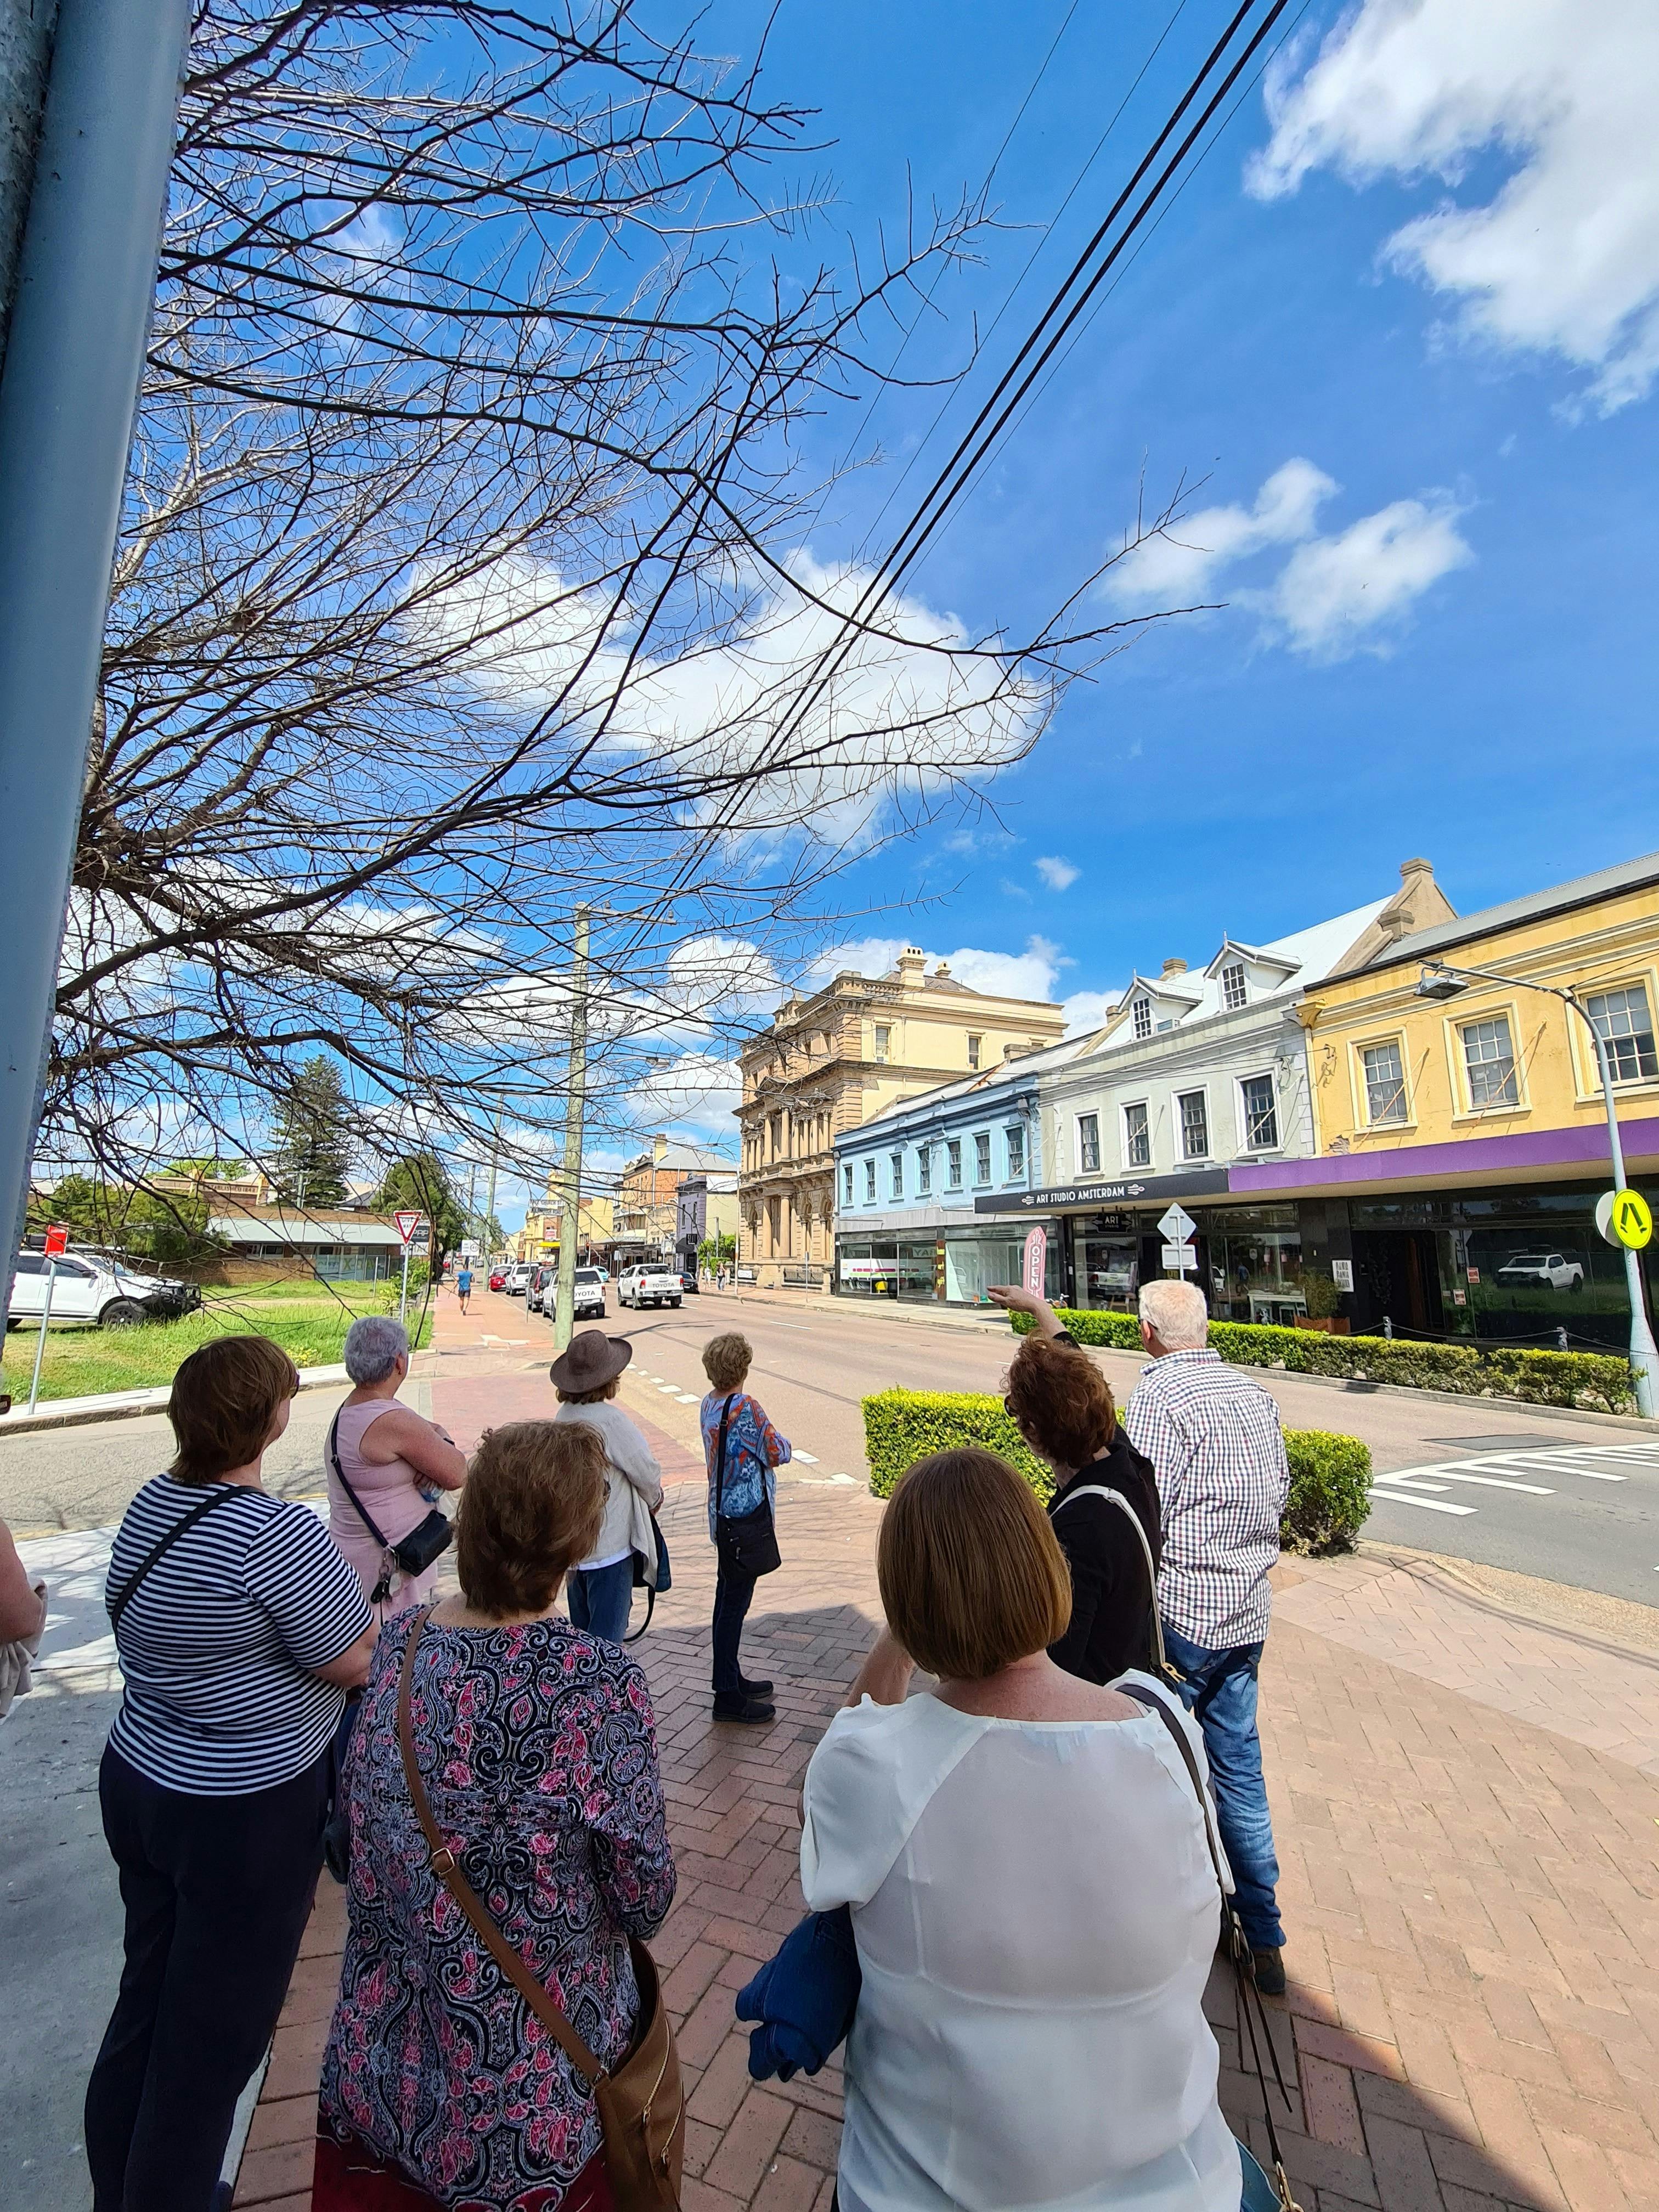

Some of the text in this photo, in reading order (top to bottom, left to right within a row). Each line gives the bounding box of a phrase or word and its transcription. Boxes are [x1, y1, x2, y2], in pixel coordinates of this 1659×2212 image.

[1036, 1186, 1125, 1204] ART STUDIO AMSTERDAM
[1104, 1216, 1119, 1224] ART
[1031, 1246, 1040, 1288] OPEN
